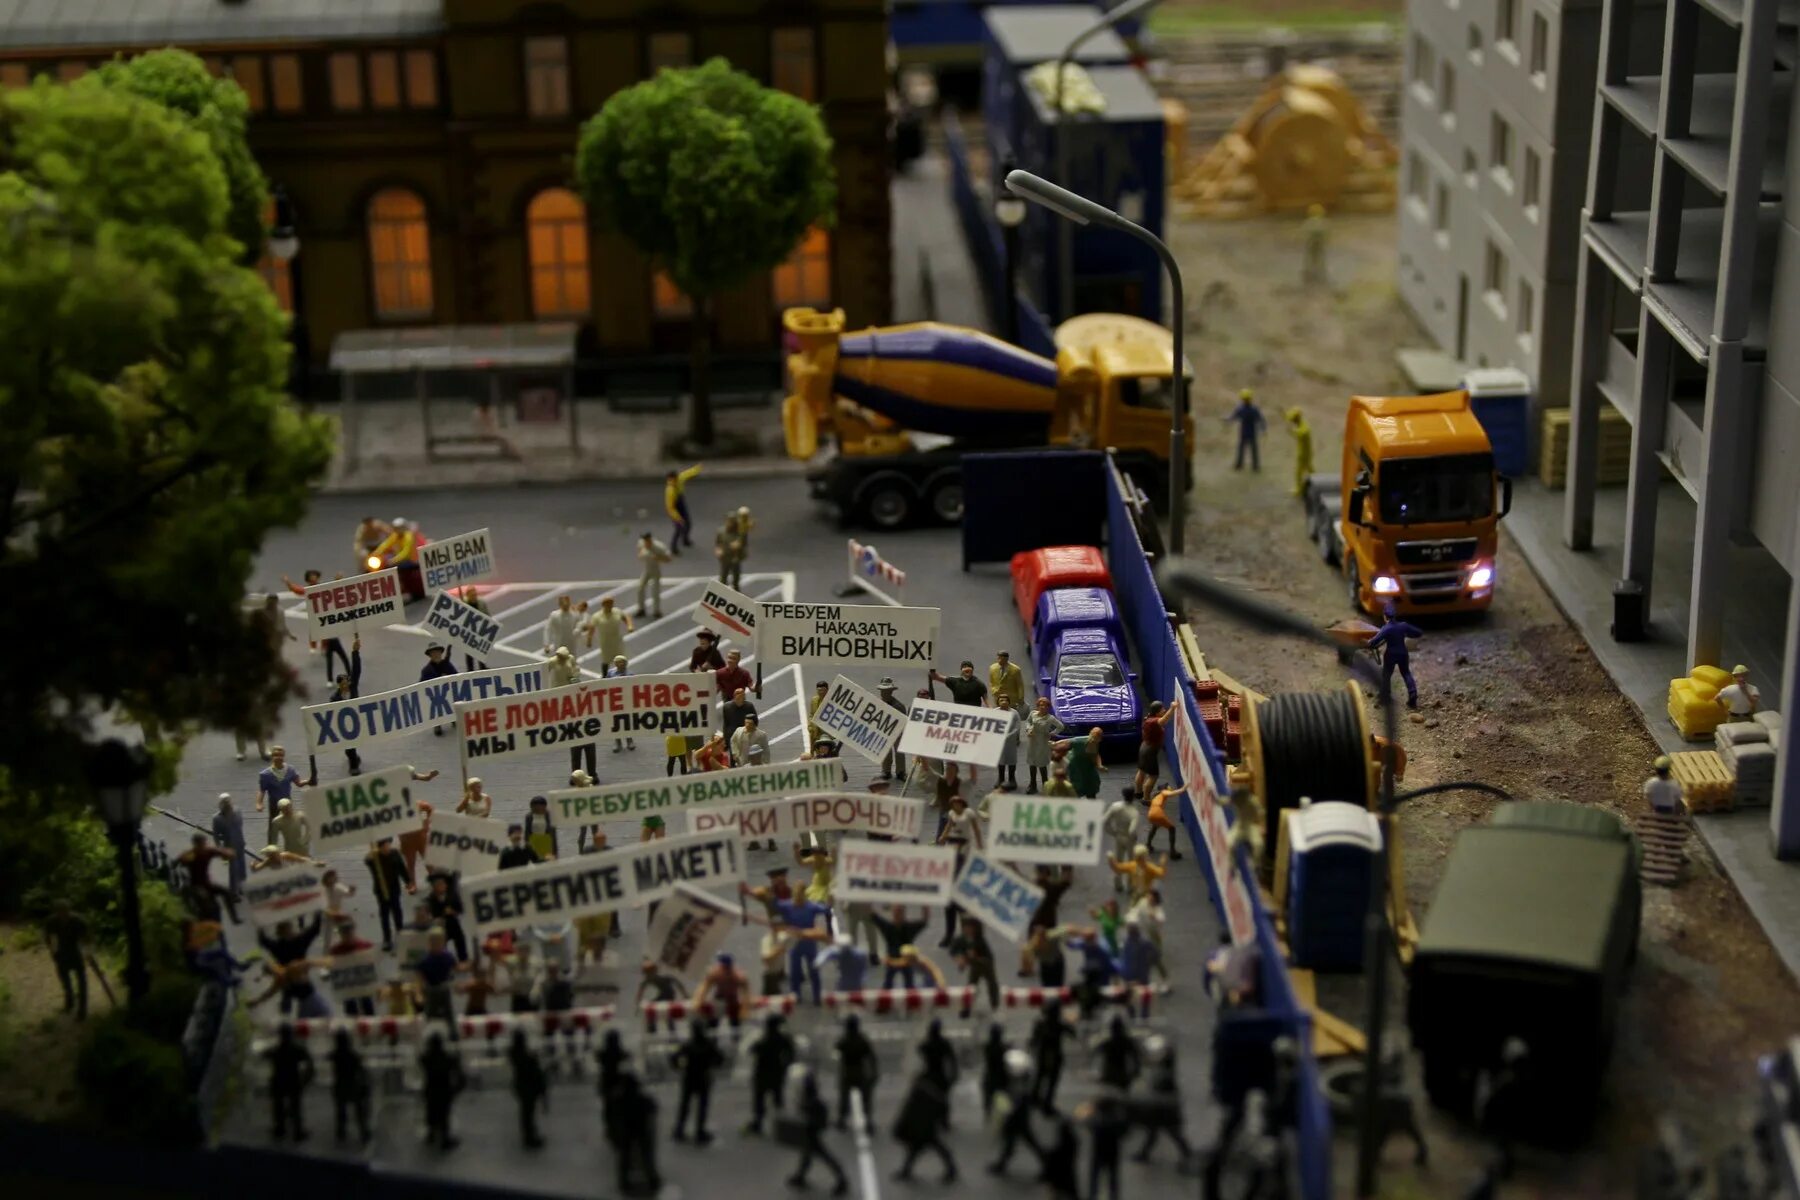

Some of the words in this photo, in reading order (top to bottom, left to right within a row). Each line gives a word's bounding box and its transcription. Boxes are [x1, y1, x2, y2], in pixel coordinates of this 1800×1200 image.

[424, 546, 451, 568] МЫ
[454, 536, 486, 560] ВАМ
[426, 555, 492, 588] ВЕРИМ!!!
[308, 574, 397, 614] ТРЕБУЕМ
[318, 601, 395, 627] УВАЖЕНИЯ
[434, 594, 500, 642] РУКИ
[762, 603, 841, 620] ТРЕБУЕМ
[816, 620, 898, 637] НАКАЗАТЬ
[782, 635, 933, 661] ВИНОВНЫХ!
[313, 691, 423, 746] ХОТИМ
[464, 707, 498, 737] НЕ
[504, 686, 625, 732] ЛОМАЙТЕ
[831, 684, 864, 716] МЫ
[860, 703, 899, 737] ВАМ
[910, 707, 1009, 735] БЕРЕГИТЕ
[819, 703, 888, 756] ВЕРИМ!!!
[924, 725, 982, 745] МАКЕТ
[325, 777, 390, 817] НАС
[557, 786, 671, 820] ТРЕБУЕМ
[791, 798, 917, 836] ПРОЧЬ!!!
[1013, 801, 1076, 831] НАС
[430, 830, 499, 855] ПРОЧЬ
[471, 865, 623, 925] БЕРЕГИТЕ
[632, 838, 737, 893] МАКЕТ!
